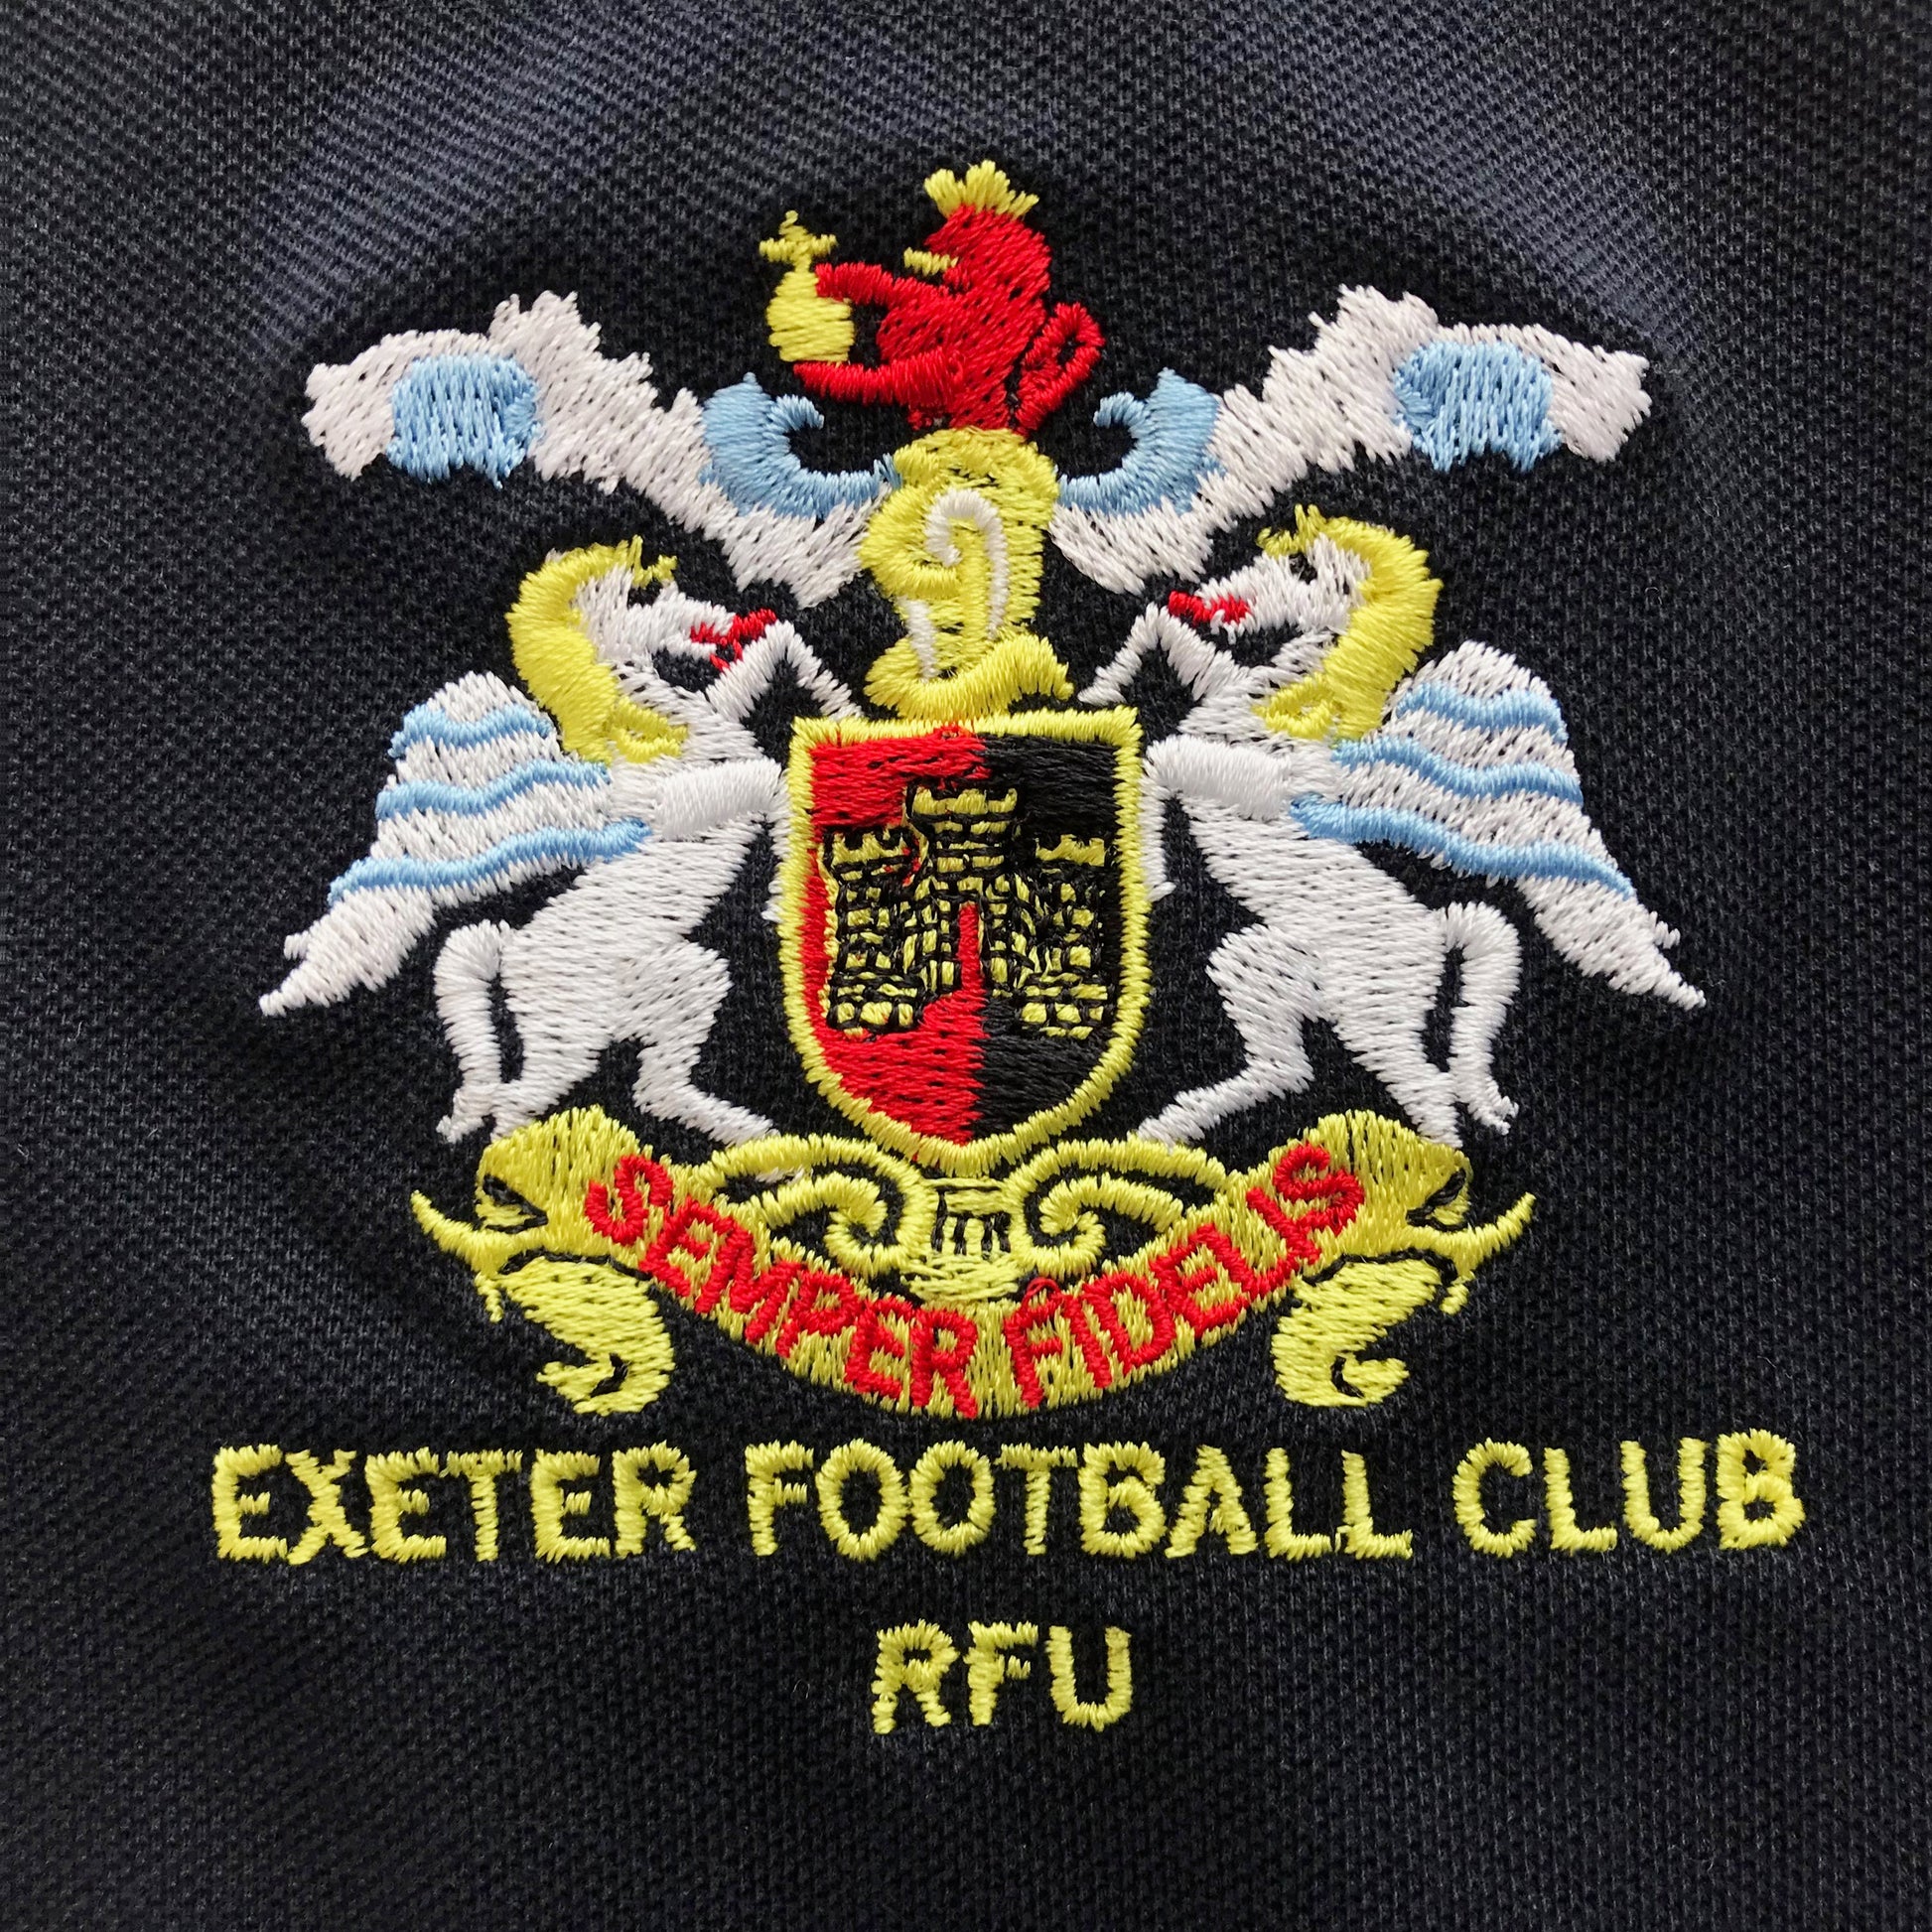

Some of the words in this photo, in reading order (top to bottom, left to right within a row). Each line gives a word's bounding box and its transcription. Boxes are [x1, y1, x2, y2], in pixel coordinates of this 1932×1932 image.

[585, 1156, 978, 1419] SEMPER
[1004, 1144, 1365, 1408] FIDELIS
[212, 1443, 697, 1566] EXETER
[746, 1438, 1413, 1562] FOOTBALL
[1453, 1428, 1807, 1558] CLUB
[872, 1620, 1133, 1734] RFU
